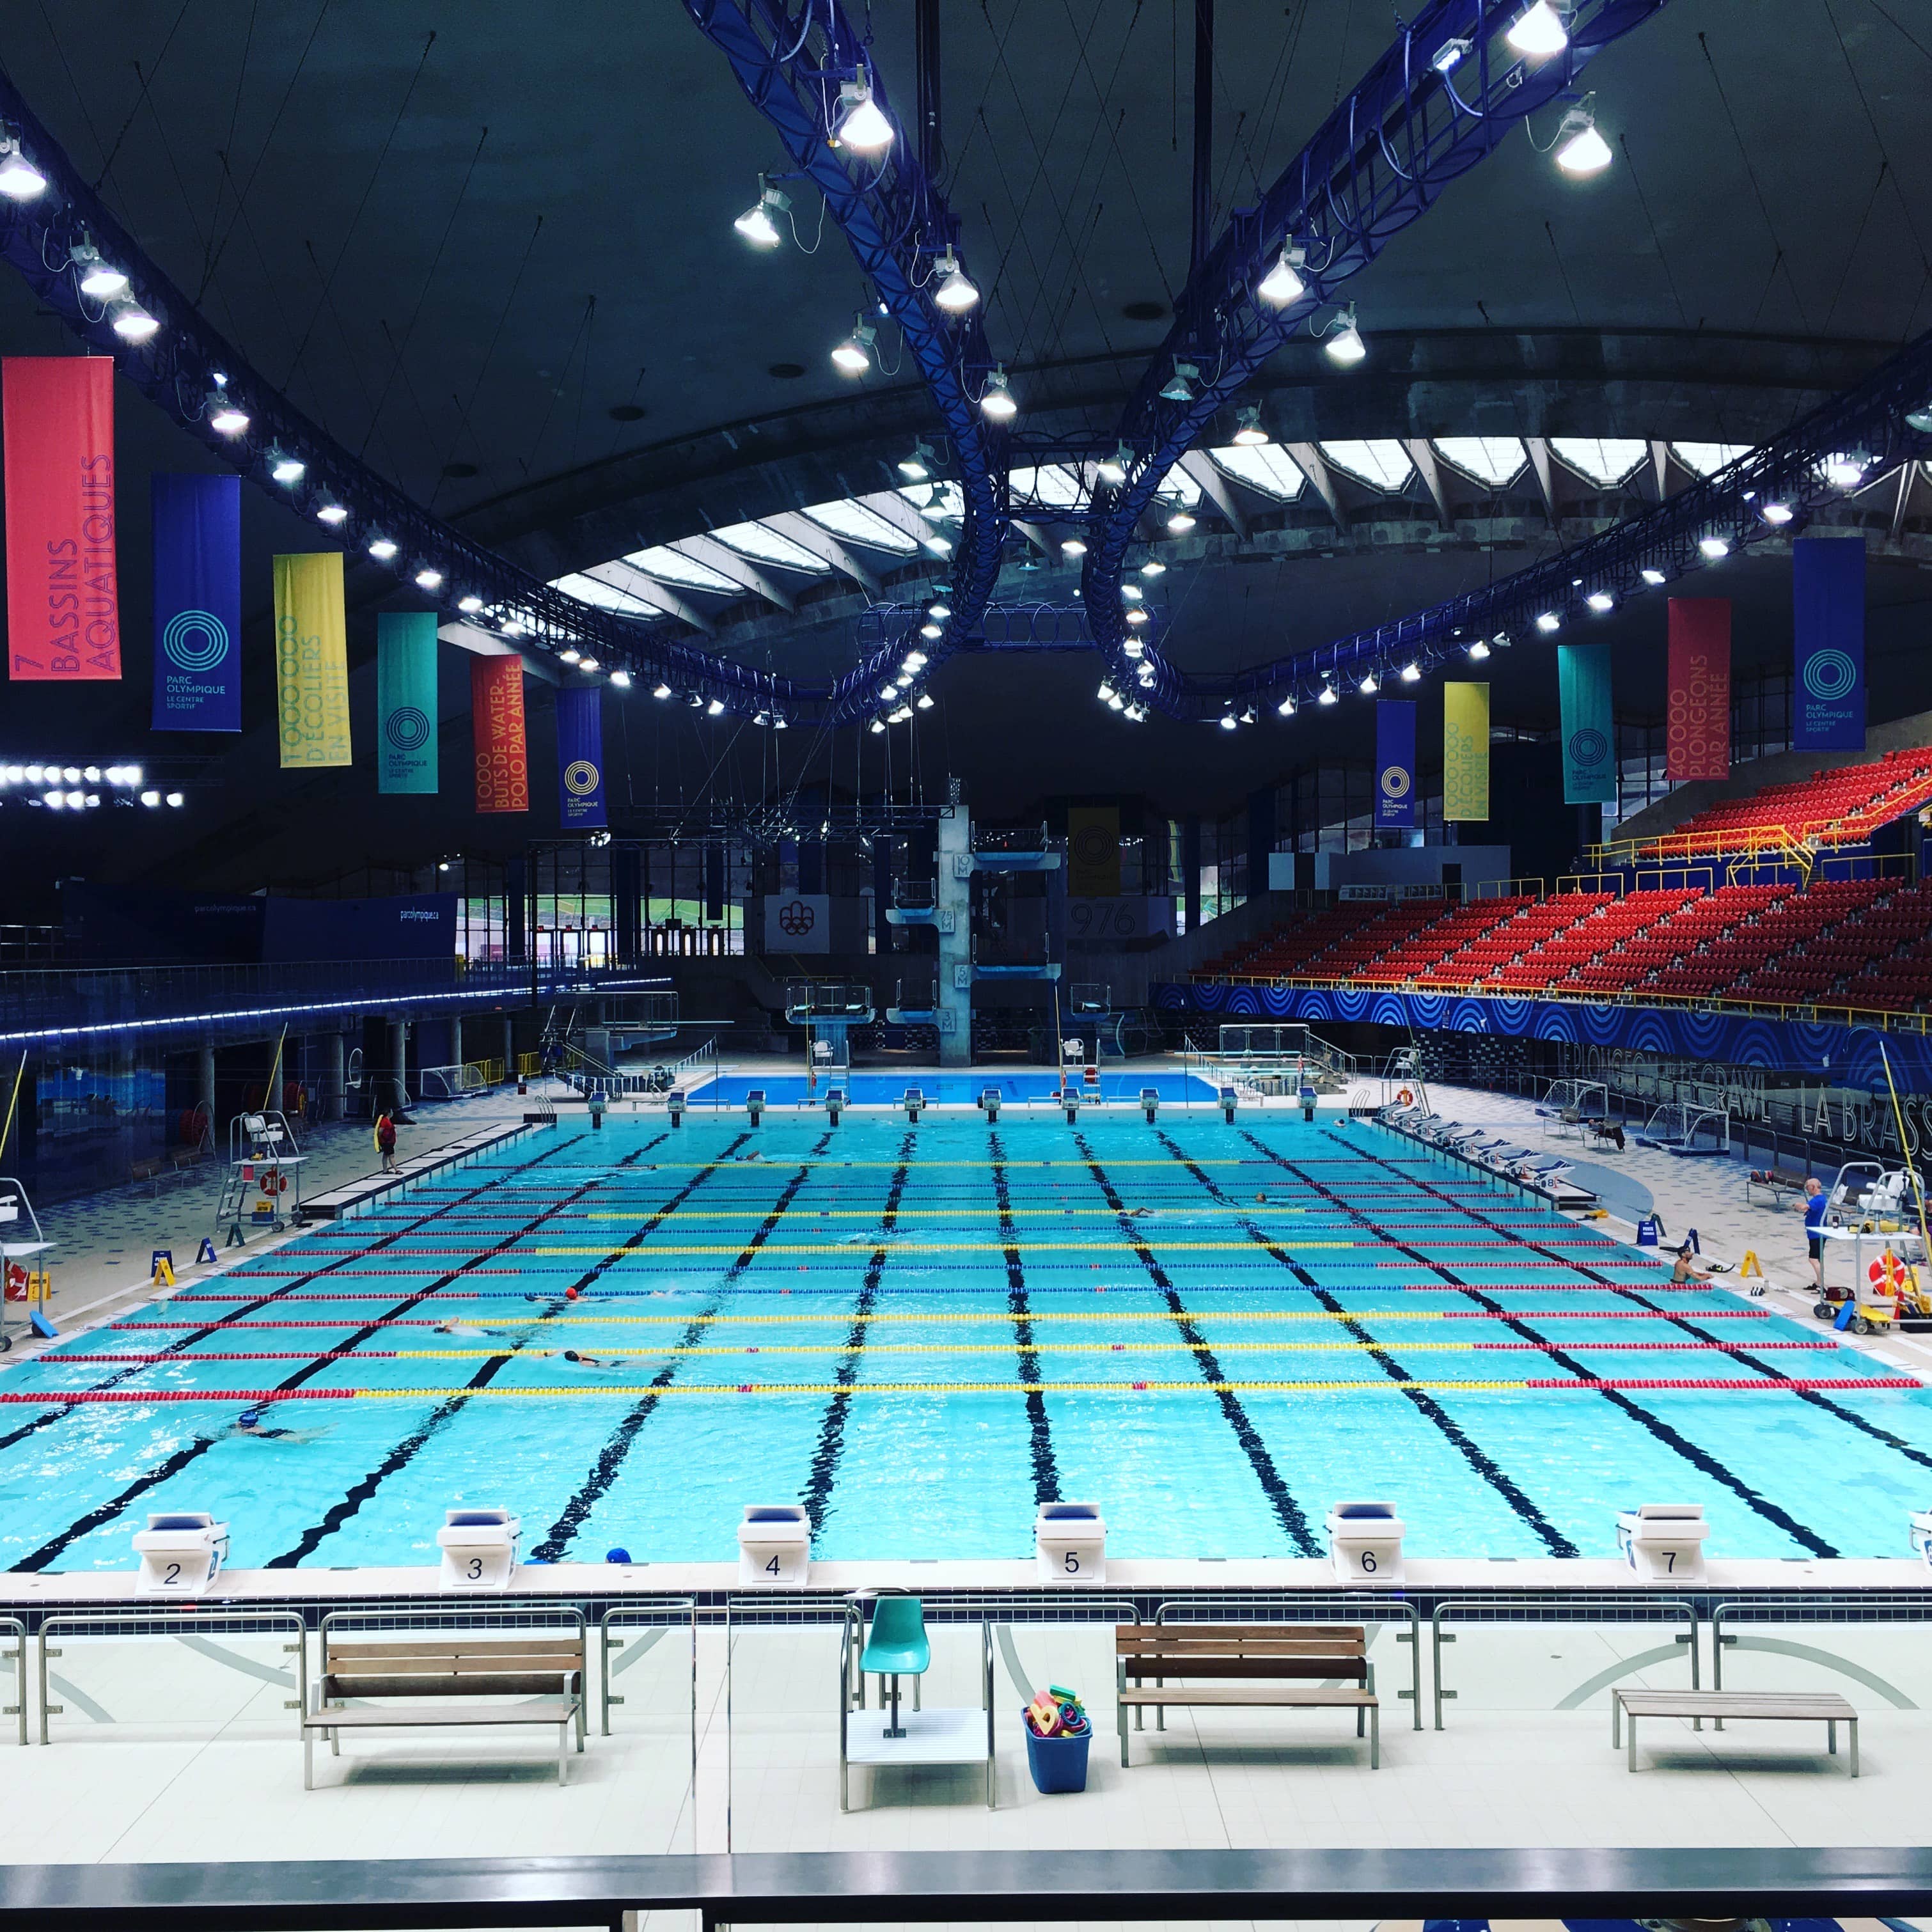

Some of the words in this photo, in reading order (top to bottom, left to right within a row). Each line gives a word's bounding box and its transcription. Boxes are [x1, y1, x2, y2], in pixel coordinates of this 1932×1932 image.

[81, 454, 116, 671] AQUATIQUES
[47, 538, 80, 672] BASSINS
[14, 654, 44, 671] 7
[166, 675, 192, 684] PARC
[166, 684, 226, 695] OLYMPIQUE
[325, 661, 348, 727] VISITE
[503, 664, 522, 718] ANNÉE
[490, 678, 507, 740] WATER-
[1689, 655, 1708, 776] PLONGEONS
[1805, 711, 1853, 719] OLYMPIQUE
[329, 735, 349, 762] EN
[509, 722, 524, 754] PAR
[492, 745, 508, 765] DE
[1669, 747, 1686, 776] 40
[1709, 741, 1726, 776] PAR
[494, 770, 510, 808] BUTS
[510, 759, 526, 808] POLO
[957, 855, 970, 865] 10
[958, 865, 968, 875] M
[941, 921, 952, 930] M
[957, 977, 968, 985] M
[959, 966, 966, 977] 5
[942, 1020, 952, 1030] M
[945, 1011, 951, 1021] 3
[1701, 1064, 1771, 1124] CRAWL
[1801, 1080, 1833, 1138] LA
[1548, 1179, 1554, 1187] 8
[467, 1558, 482, 1579] 3
[766, 1555, 780, 1576] 4
[1065, 1551, 1080, 1573] 5
[1362, 1551, 1377, 1573] 6
[1662, 1552, 1676, 1573] 7
[164, 1563, 181, 1584] 2
